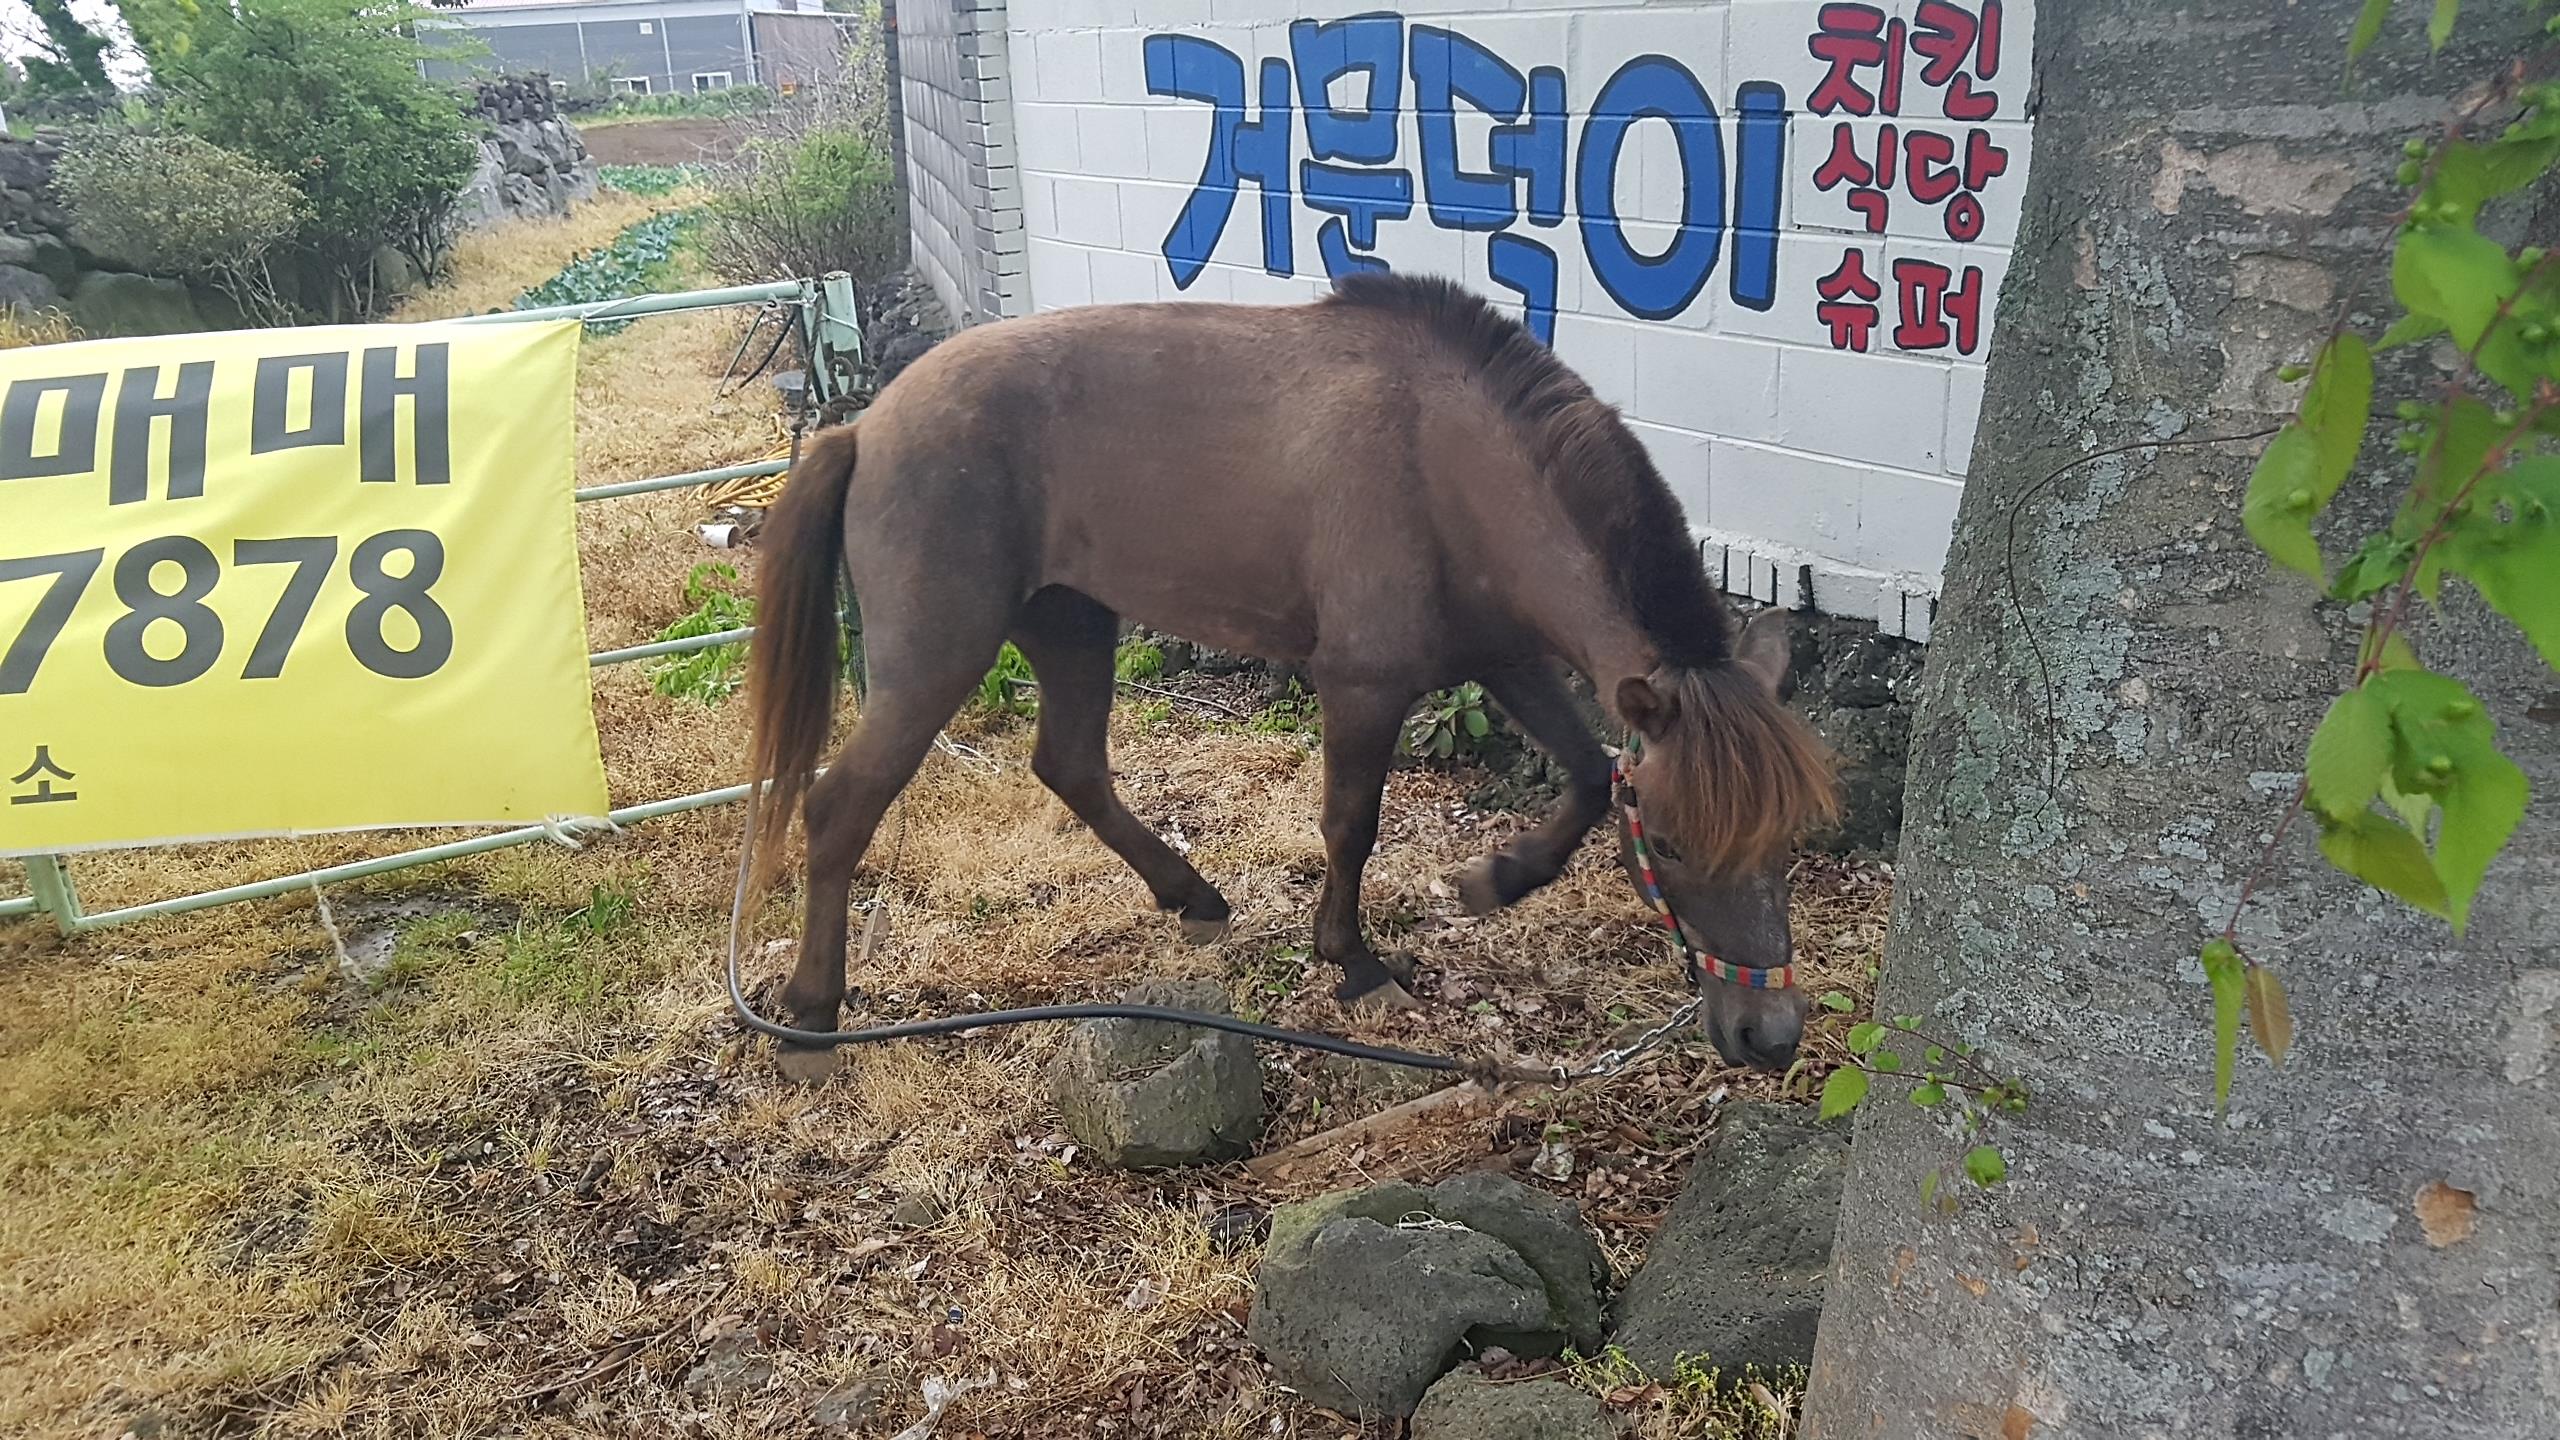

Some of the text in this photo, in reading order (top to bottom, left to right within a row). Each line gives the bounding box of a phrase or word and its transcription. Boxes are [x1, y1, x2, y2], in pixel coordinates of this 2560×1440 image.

[1807, 0, 2003, 121] 치킨
[1813, 122, 2008, 242] 식당
[1816, 248, 1983, 356] 슈퍼
[0, 528, 454, 694] 7878
[9, 745, 79, 806] 소
